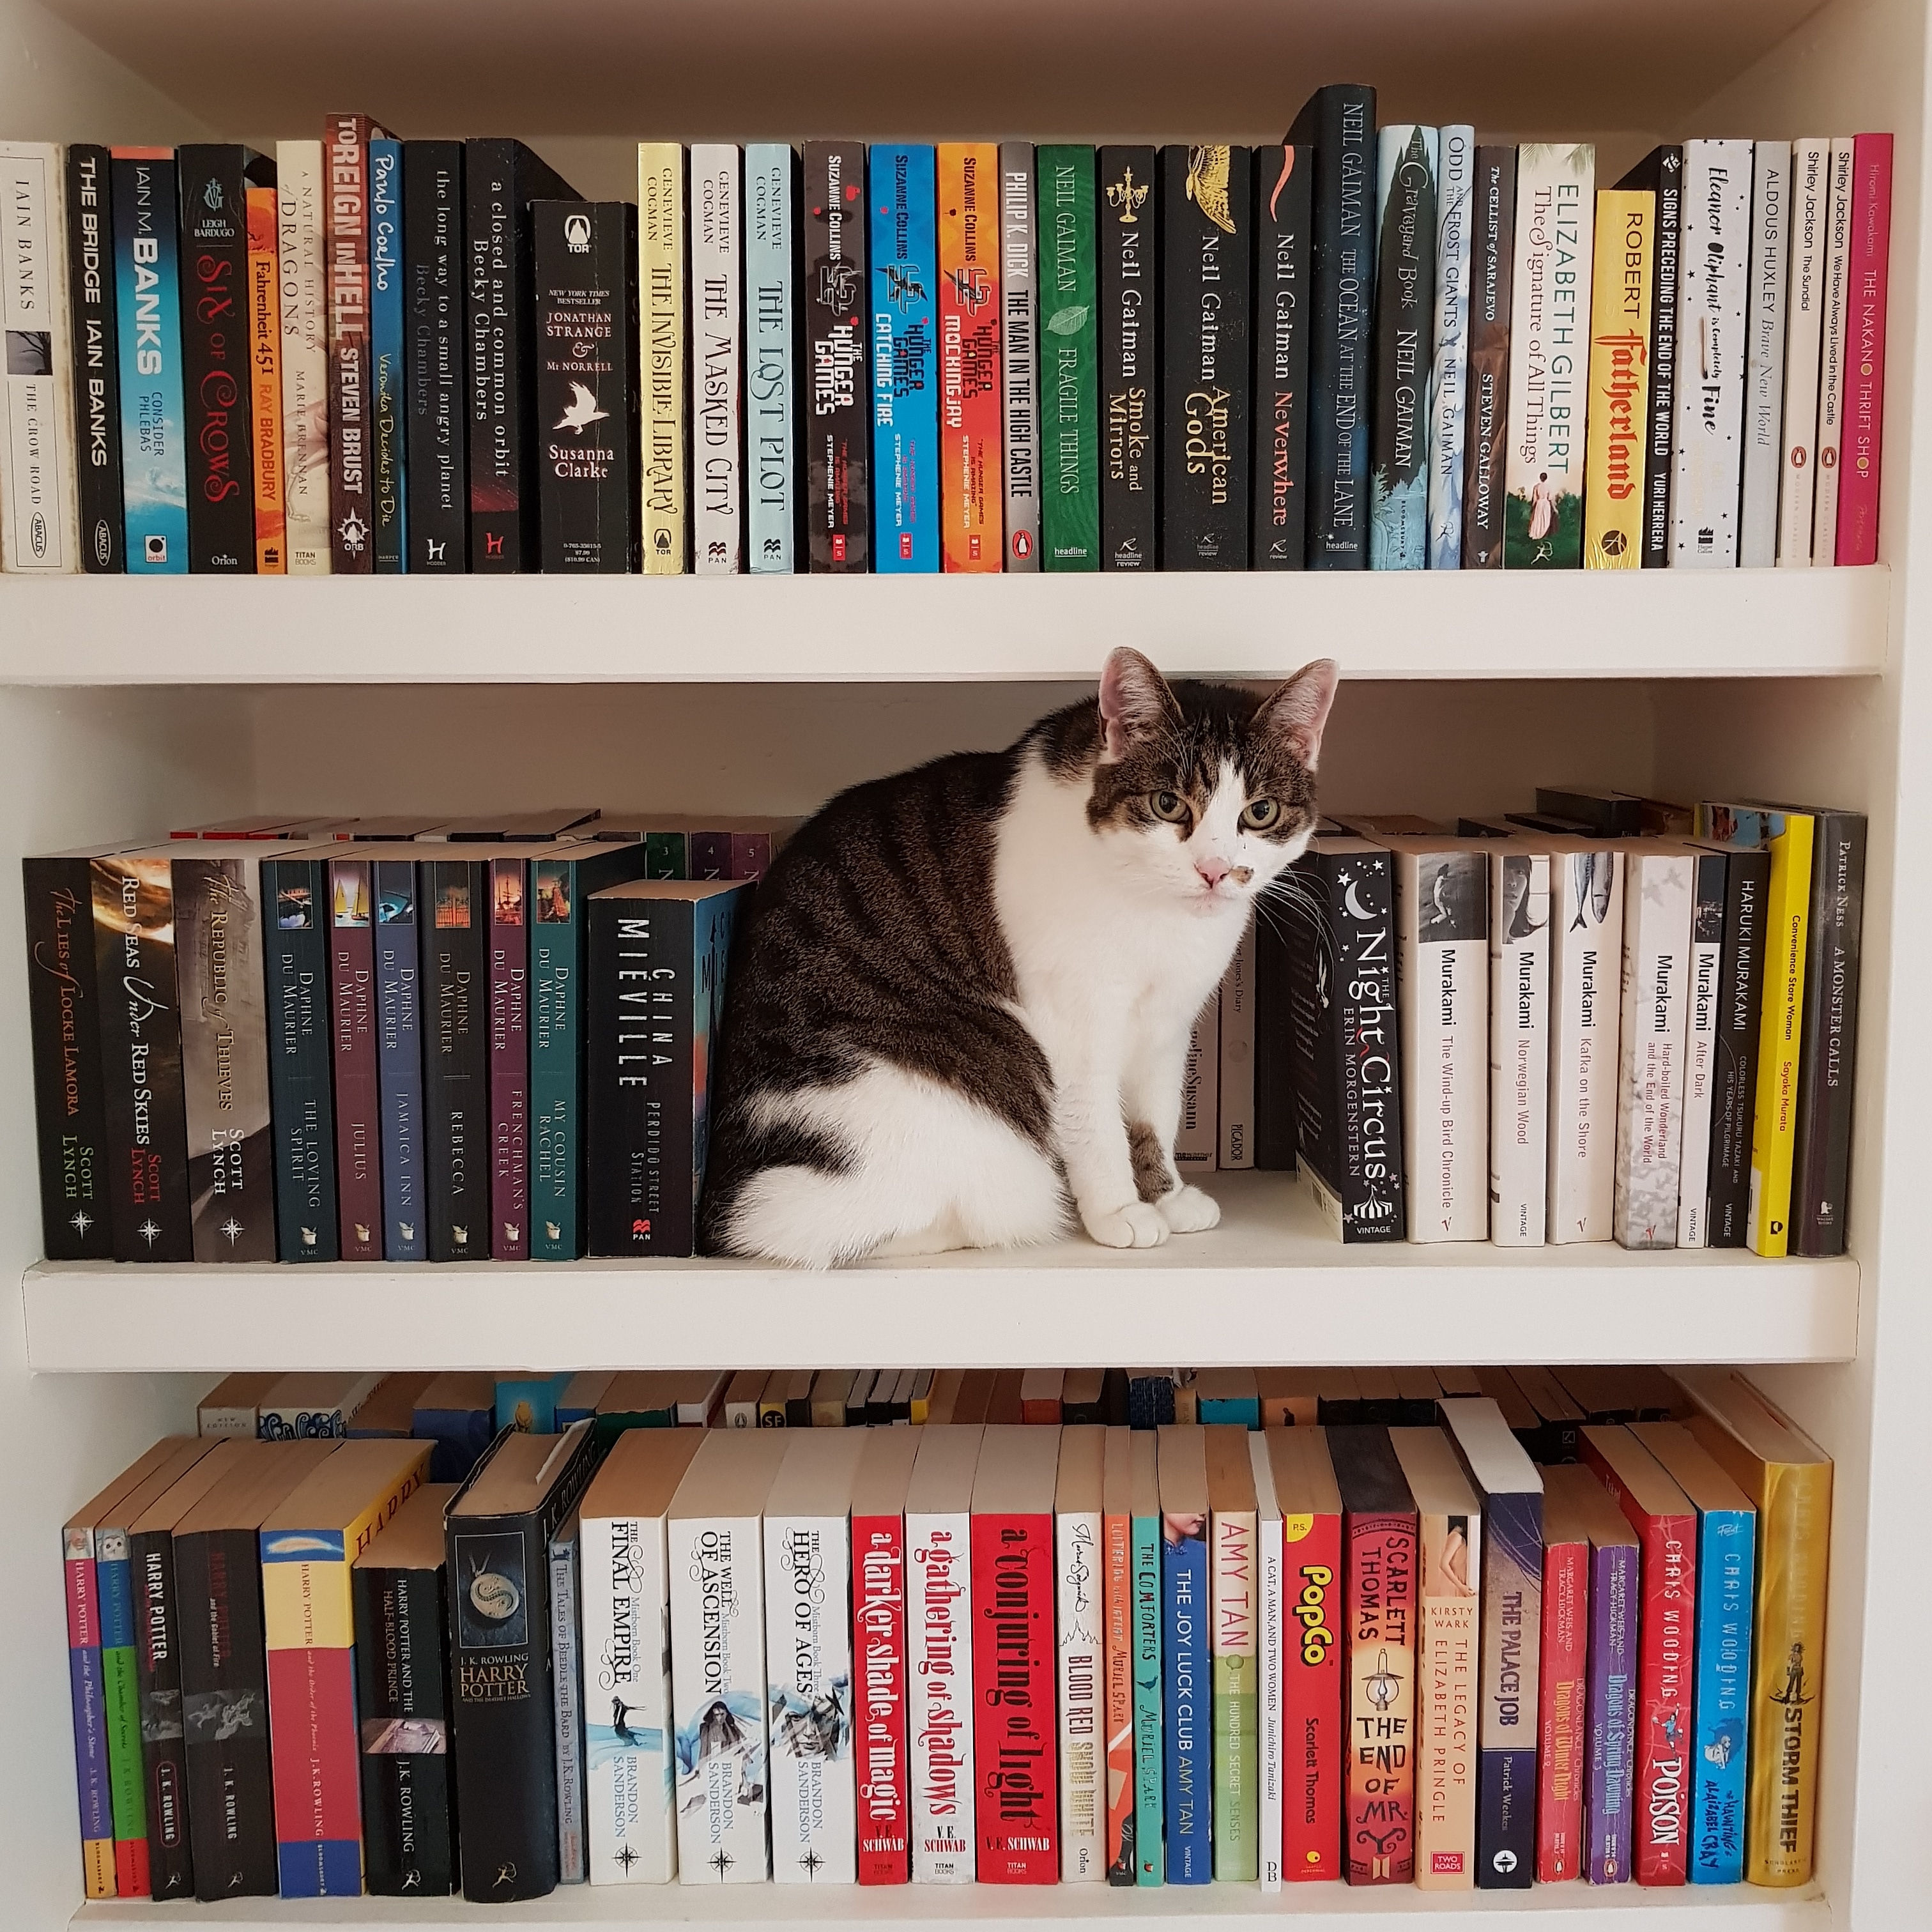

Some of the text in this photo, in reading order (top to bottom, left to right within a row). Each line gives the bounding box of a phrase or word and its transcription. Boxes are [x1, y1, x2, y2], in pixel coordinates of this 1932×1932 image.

[15, 180, 35, 309] IAIN BANKS
[194, 228, 234, 238] BARDUGO
[202, 219, 226, 228] LEIGH
[567, 244, 589, 253] TOR
[1624, 213, 1643, 319] ROBERT
[1761, 169, 1779, 313] ALDOUS HUXLEY
[1801, 151, 1820, 312] Shirley Jackson The Sundial
[80, 158, 107, 466] THE BRIDGE IAIN BANKS
[134, 238, 163, 376] BANKS
[546, 312, 611, 323] JONATHAN
[546, 326, 611, 338] STRANGE
[1548, 185, 1579, 474] ELIZABETH GILBERT
[196, 256, 240, 502] SIX CROWS
[255, 261, 276, 501] Fahrenheit 451 RAY BRADBURY
[562, 362, 613, 371] NORRELL
[645, 263, 678, 514] THE INVISIBLE LIBRARY
[758, 280, 785, 512] THE PLOT
[815, 341, 835, 415] GAMES
[827, 325, 854, 406] HUNGER
[875, 313, 893, 427] CATCHING FIRE
[25, 384, 43, 505] THE CROW ROAD
[139, 395, 151, 452] PHLEBAS
[151, 392, 164, 457] CONSIDER
[341, 348, 362, 494] STEVEN BRUST
[549, 444, 615, 461] Susanna
[1058, 348, 1080, 494] FRAGILE THINGS
[1109, 394, 1127, 480] Mirrors
[1129, 388, 1149, 459] Smoke
[1184, 392, 1215, 475] Gods
[1212, 385, 1231, 505] American
[1273, 392, 1294, 526] Neverwhere
[1856, 383, 1872, 478] THRIFT SHOP
[555, 463, 608, 479] Clarke
[33, 518, 44, 553] ABACUS
[148, 554, 166, 562] orbit
[211, 555, 238, 565] Orion
[1054, 548, 1087, 556] headline
[663, 847, 668, 855] 3
[708, 847, 714, 855] 4
[748, 848, 755, 857] 5
[1349, 926, 1395, 1046] Night
[1381, 977, 1390, 999] THE
[1733, 880, 1755, 1031] HARUKI MURAKAMI
[1785, 915, 1801, 1041] Convenience Store Woman
[121, 877, 153, 1145] RED RED SKIES
[281, 954, 297, 1055] DU MAURIER
[299, 972, 314, 1036] DAPHNE
[617, 919, 650, 1086] MIÉVILLE
[652, 969, 675, 1066] CHINA
[1579, 951, 1597, 1074] Murakami Kafka
[1343, 1007, 1360, 1177] ERIN MORGENSTERN
[1439, 949, 1457, 1209] Murakami Wind-up Bird Chronicle
[1515, 952, 1535, 1145] Murakami Norwegian Wood
[211, 1129, 227, 1194] LYNCH
[229, 1128, 245, 1190] SCOTT
[351, 1123, 367, 1180] JULIUS
[395, 1092, 411, 1206] JAMAICA INN
[451, 1111, 464, 1196] REBECCA
[498, 1123, 509, 1177] CREEK
[539, 1116, 552, 1182] RACHEL
[647, 1102, 661, 1213] PERDIDO STREET
[1231, 1124, 1243, 1162] PICADOR
[1360, 1056, 1392, 1179] Circus
[553, 1132, 567, 1198] COUSIN
[631, 1153, 645, 1204] STATION
[1356, 1225, 1391, 1234] VINTAGE
[765, 1414, 781, 1426] SF
[146, 1552, 167, 1660] HARRY POTTER
[611, 1522, 632, 1683] FINAL EMPIRE
[719, 1531, 733, 1607] THE WELL
[793, 1531, 813, 1694] HERO OF AGES
[1221, 1522, 1250, 1646] AMY TAN
[1358, 1547, 1381, 1641] THOMAS
[1385, 1537, 1409, 1646] SCARLETT
[1431, 1607, 1473, 1616] KIRSTY
[702, 1566, 722, 1694] ASCENSION
[1293, 1565, 1334, 1667] PopCo
[1434, 1620, 1469, 1629] WARK
[1499, 1591, 1522, 1694] THE PALACE
[914, 1548, 967, 1816] gathering shadows
[1066, 1655, 1094, 1735] BLOOD RED
[1176, 1569, 1193, 1834] THE JOY LUCK CLUB AMY TAN
[1453, 1639, 1468, 1785] THE LEGACY OF
[1356, 1717, 1407, 1739] THE
[1360, 1744, 1406, 1774] END
[1432, 1640, 1448, 1823] ELIZABETH PRINGLE
[400, 1787, 415, 1853] ROWLING
[613, 1757, 625, 1838] SANDERSON
[626, 1756, 638, 1824] BRANDON
[1365, 1777, 1400, 1795] OF
[1649, 1758, 1686, 1846] POISON
[1779, 1707, 1802, 1853] STORM THIEF
[924, 1839, 966, 1853] SCHWAB
